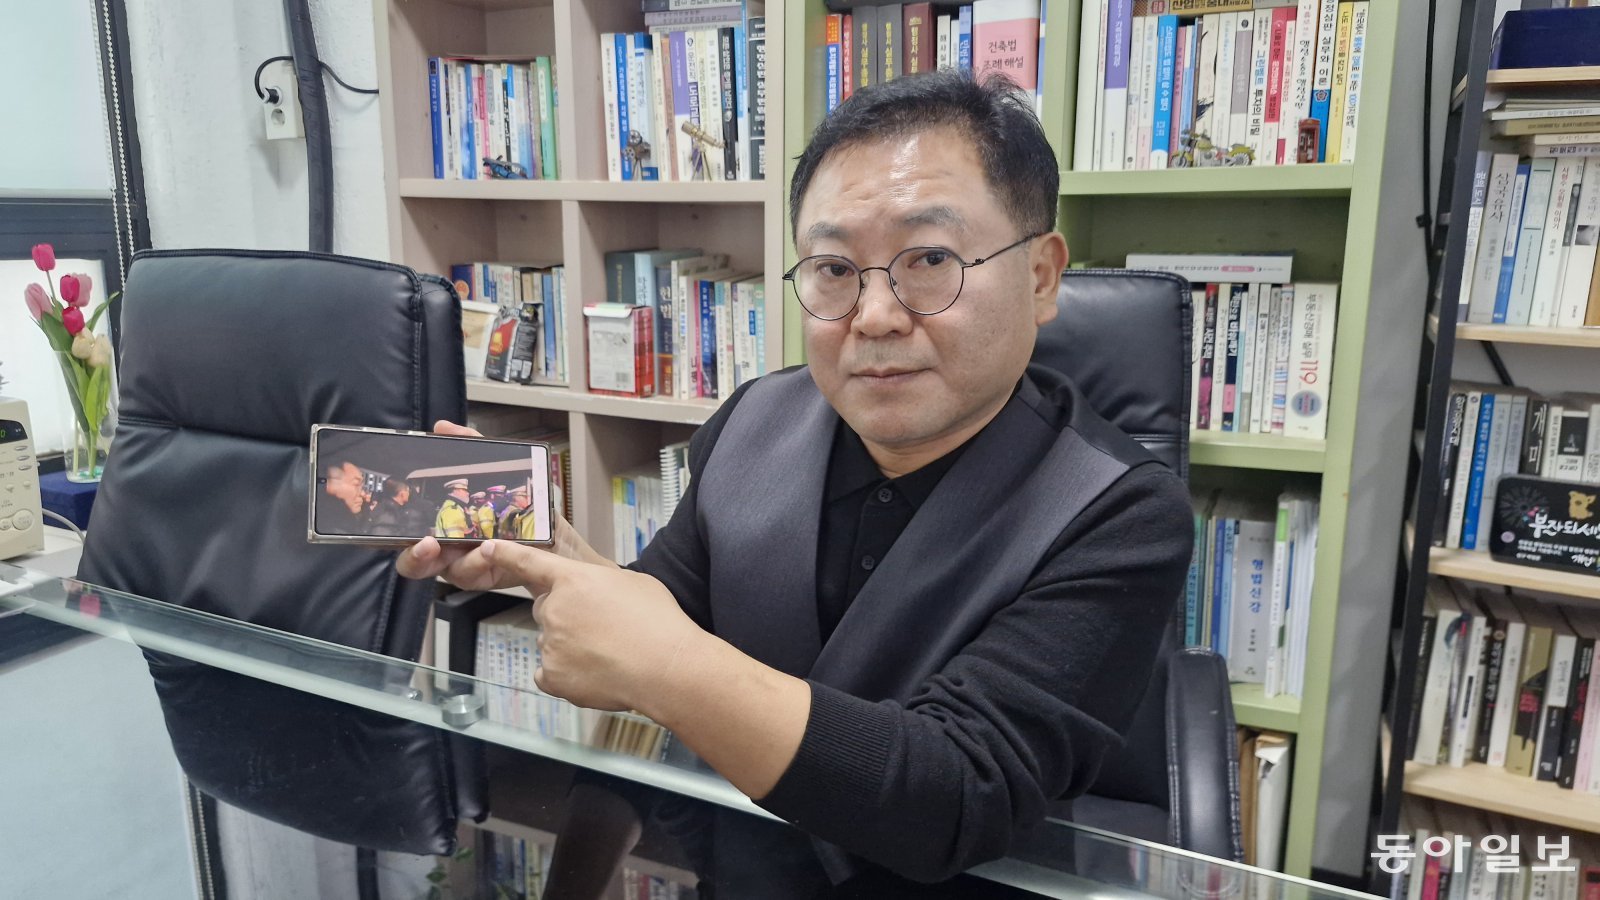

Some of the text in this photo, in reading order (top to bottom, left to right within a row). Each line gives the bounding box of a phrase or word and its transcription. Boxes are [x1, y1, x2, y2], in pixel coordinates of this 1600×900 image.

[988, 39, 1017, 54] 건축법
[1004, 56, 1024, 69] 해설
[1249, 49, 1266, 136] 그린벨트 투자의 비밀
[1475, 170, 1486, 188] 꿈의
[1471, 189, 1484, 206] 도시
[1303, 293, 1317, 339] 부동산경매
[1299, 360, 1319, 385] 119
[1528, 403, 1547, 473] 개미
